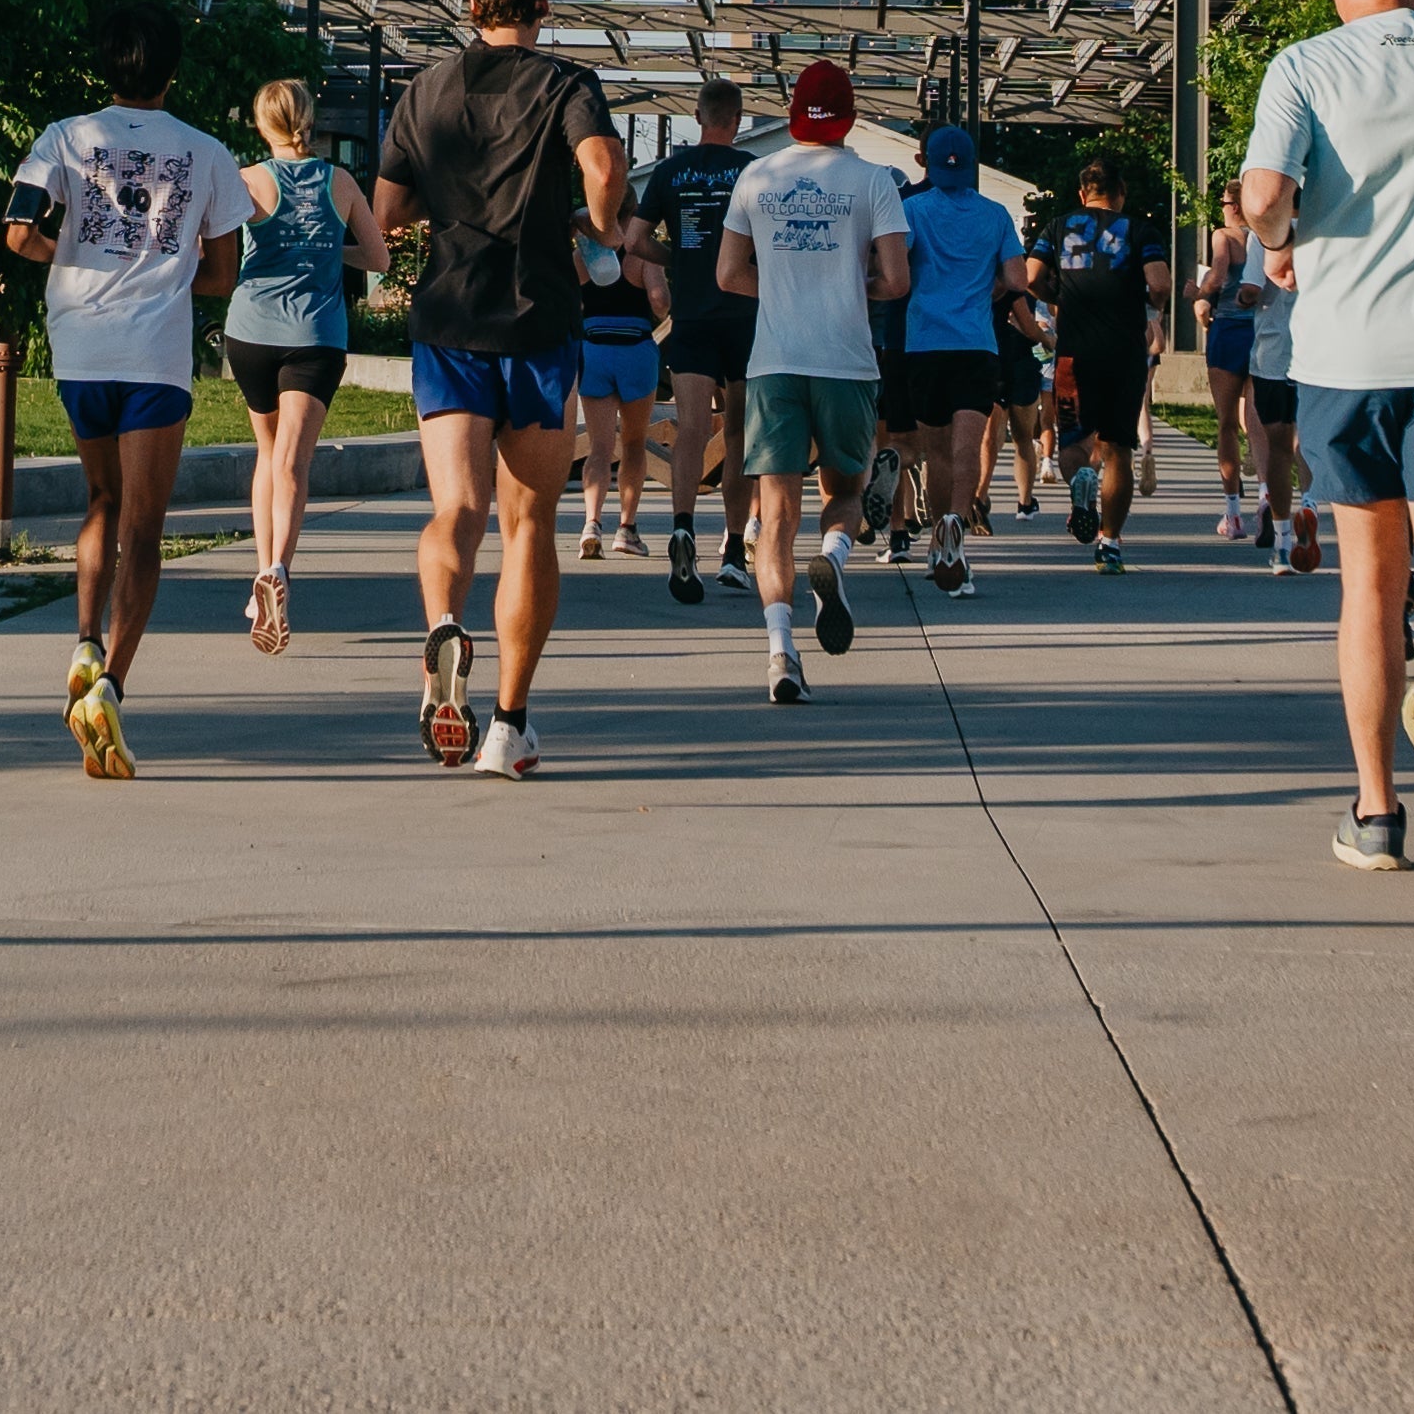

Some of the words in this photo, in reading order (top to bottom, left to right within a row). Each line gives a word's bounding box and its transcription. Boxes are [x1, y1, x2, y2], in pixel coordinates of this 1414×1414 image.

[800, 192, 856, 204] FORGET
[760, 203, 775, 214] TO
[1059, 214, 1130, 271] 24
